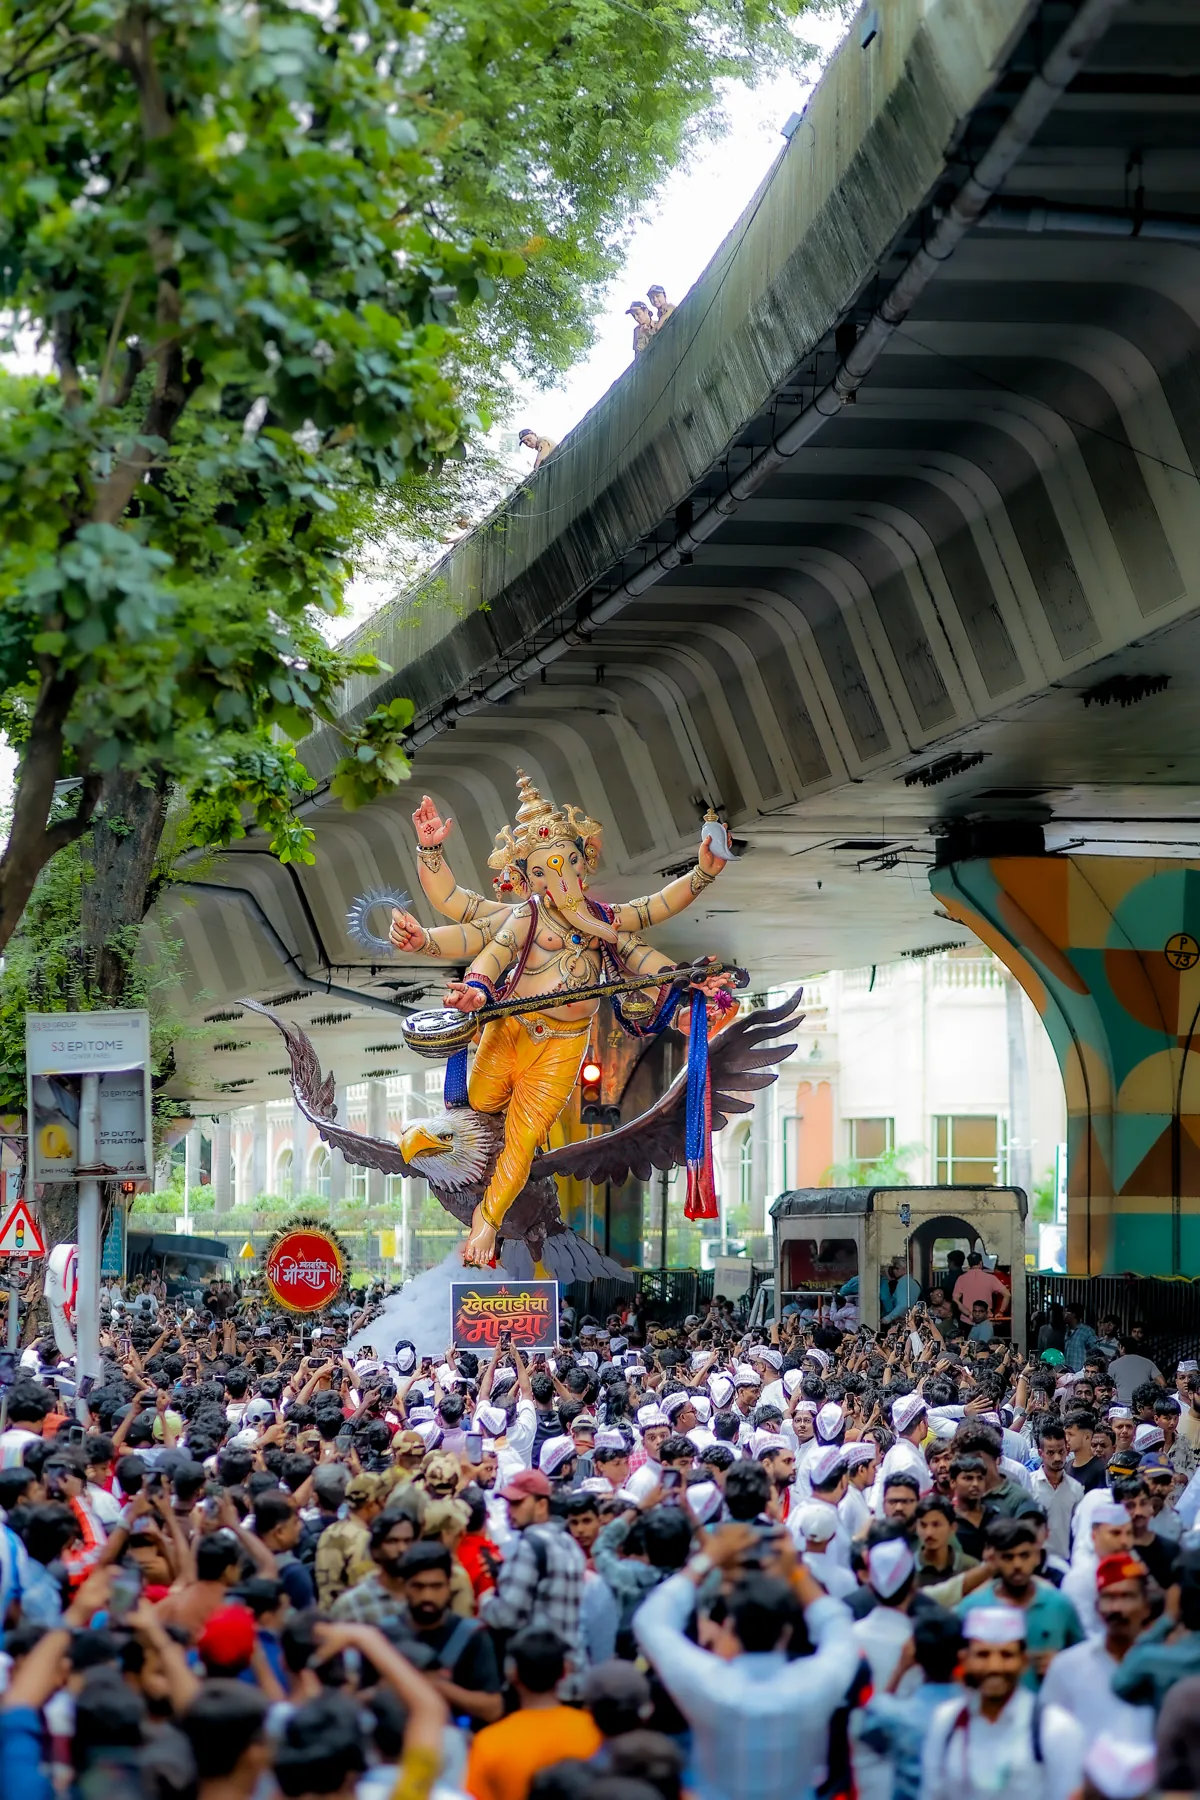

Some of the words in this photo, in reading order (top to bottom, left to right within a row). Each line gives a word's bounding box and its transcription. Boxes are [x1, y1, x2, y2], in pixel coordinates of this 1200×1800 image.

[1180, 937, 1188, 950] P
[1173, 953, 1191, 967] 73
[51, 1042, 65, 1052] S3
[279, 1256, 330, 1290] मोरया
[460, 1291, 549, 1315] खेतवाडीचा
[460, 1311, 549, 1346] मोरया
